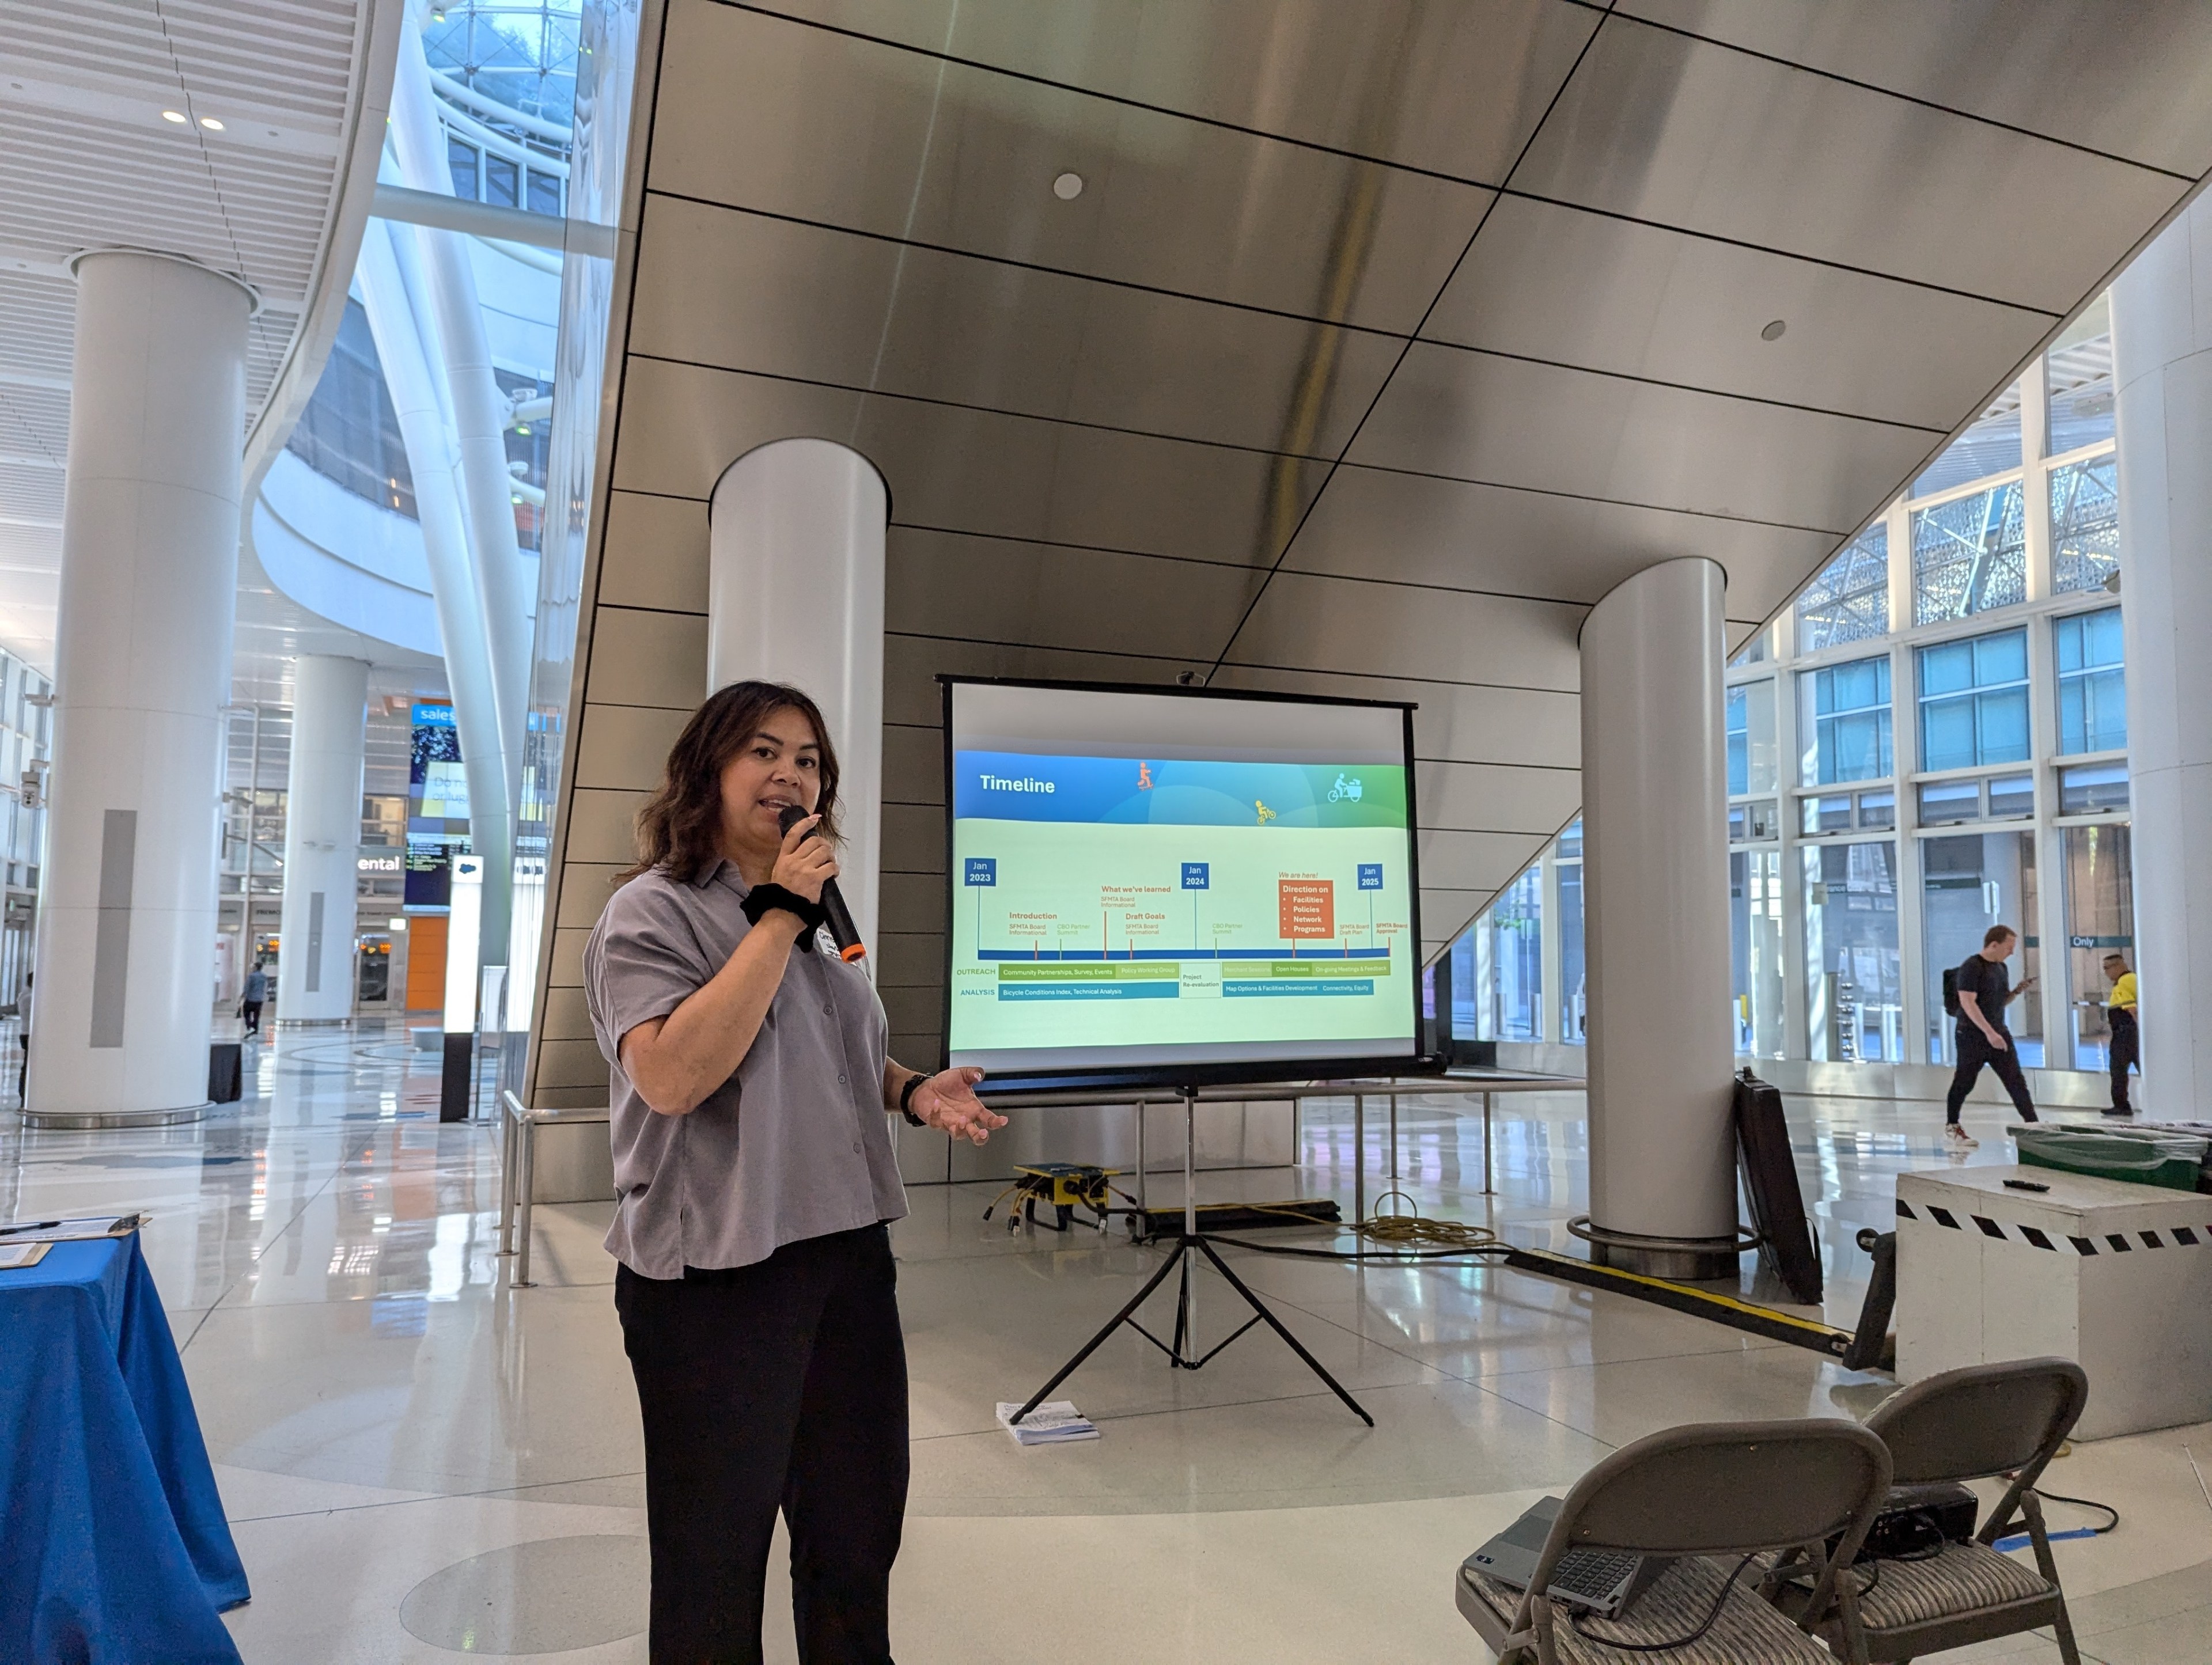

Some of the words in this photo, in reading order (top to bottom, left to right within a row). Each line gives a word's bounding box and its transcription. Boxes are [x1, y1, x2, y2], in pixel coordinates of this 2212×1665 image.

[980, 775, 1055, 794] Timeline
[358, 856, 400, 870] ental
[973, 862, 987, 870] Jan
[1188, 866, 1202, 874] Jan
[969, 874, 991, 882] 2023
[1185, 877, 1205, 886] 2024
[1294, 926, 1326, 934] Programs
[2074, 936, 2094, 947] Only
